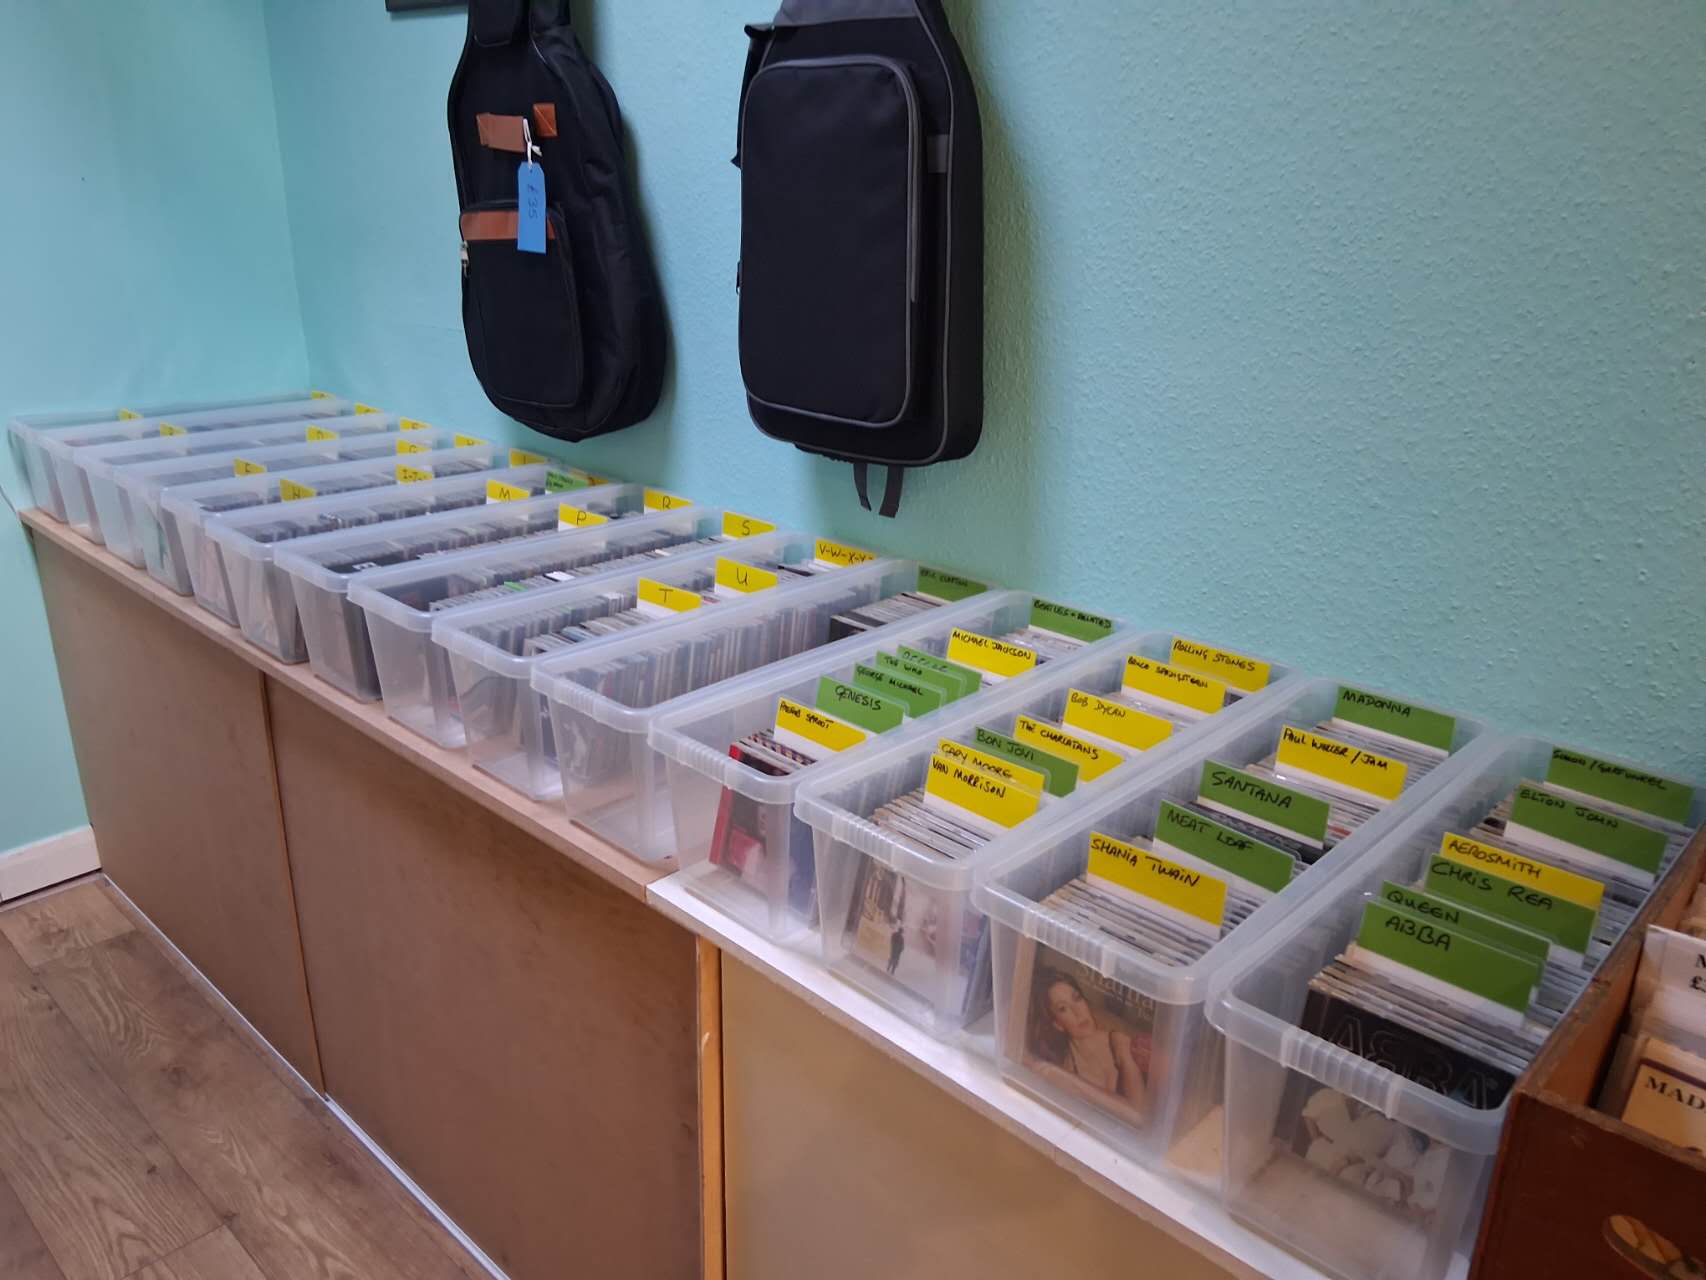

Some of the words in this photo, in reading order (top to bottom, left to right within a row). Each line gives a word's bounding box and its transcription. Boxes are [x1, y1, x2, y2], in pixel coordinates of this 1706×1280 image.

[499, 487, 511, 500] M
[662, 495, 671, 509] R
[576, 511, 587, 525] P
[741, 520, 751, 536] S
[736, 567, 749, 586] U
[658, 588, 674, 603] T
[952, 631, 989, 648] MICHAEL
[992, 642, 1032, 660] JACKSON
[1173, 640, 1208, 660] ROLLING
[1212, 653, 1256, 672] STONES
[856, 665, 884, 682] GEORGE
[888, 677, 924, 696] MICHAEL
[835, 684, 882, 711] GENESIS
[1070, 692, 1089, 707] BOB
[1094, 700, 1126, 718] DYLAN
[1342, 689, 1412, 717] MADONNA
[975, 729, 1001, 748] BON
[1007, 741, 1035, 760] JOVI
[1019, 720, 1038, 734] THE
[1040, 729, 1099, 760] CHARLATANS
[1282, 727, 1307, 745] PAUL
[932, 758, 949, 775] VAN
[972, 756, 1014, 779] MOORE
[1211, 771, 1293, 809] SANTANA
[1520, 788, 1566, 809] ELTON
[1575, 806, 1619, 829] JOHN
[1167, 808, 1212, 834] MEAT
[1216, 831, 1258, 851] LOAF
[1090, 838, 1139, 867] SHANIA
[1145, 855, 1201, 887] TWAIN
[1448, 838, 1543, 880] AEROSMITH
[1431, 861, 1494, 891] CHRIS
[1507, 885, 1553, 911] REA
[1386, 890, 1461, 925] QUEEN
[1385, 916, 1452, 952] ABBA
[1645, 1075, 1706, 1111] MAD
